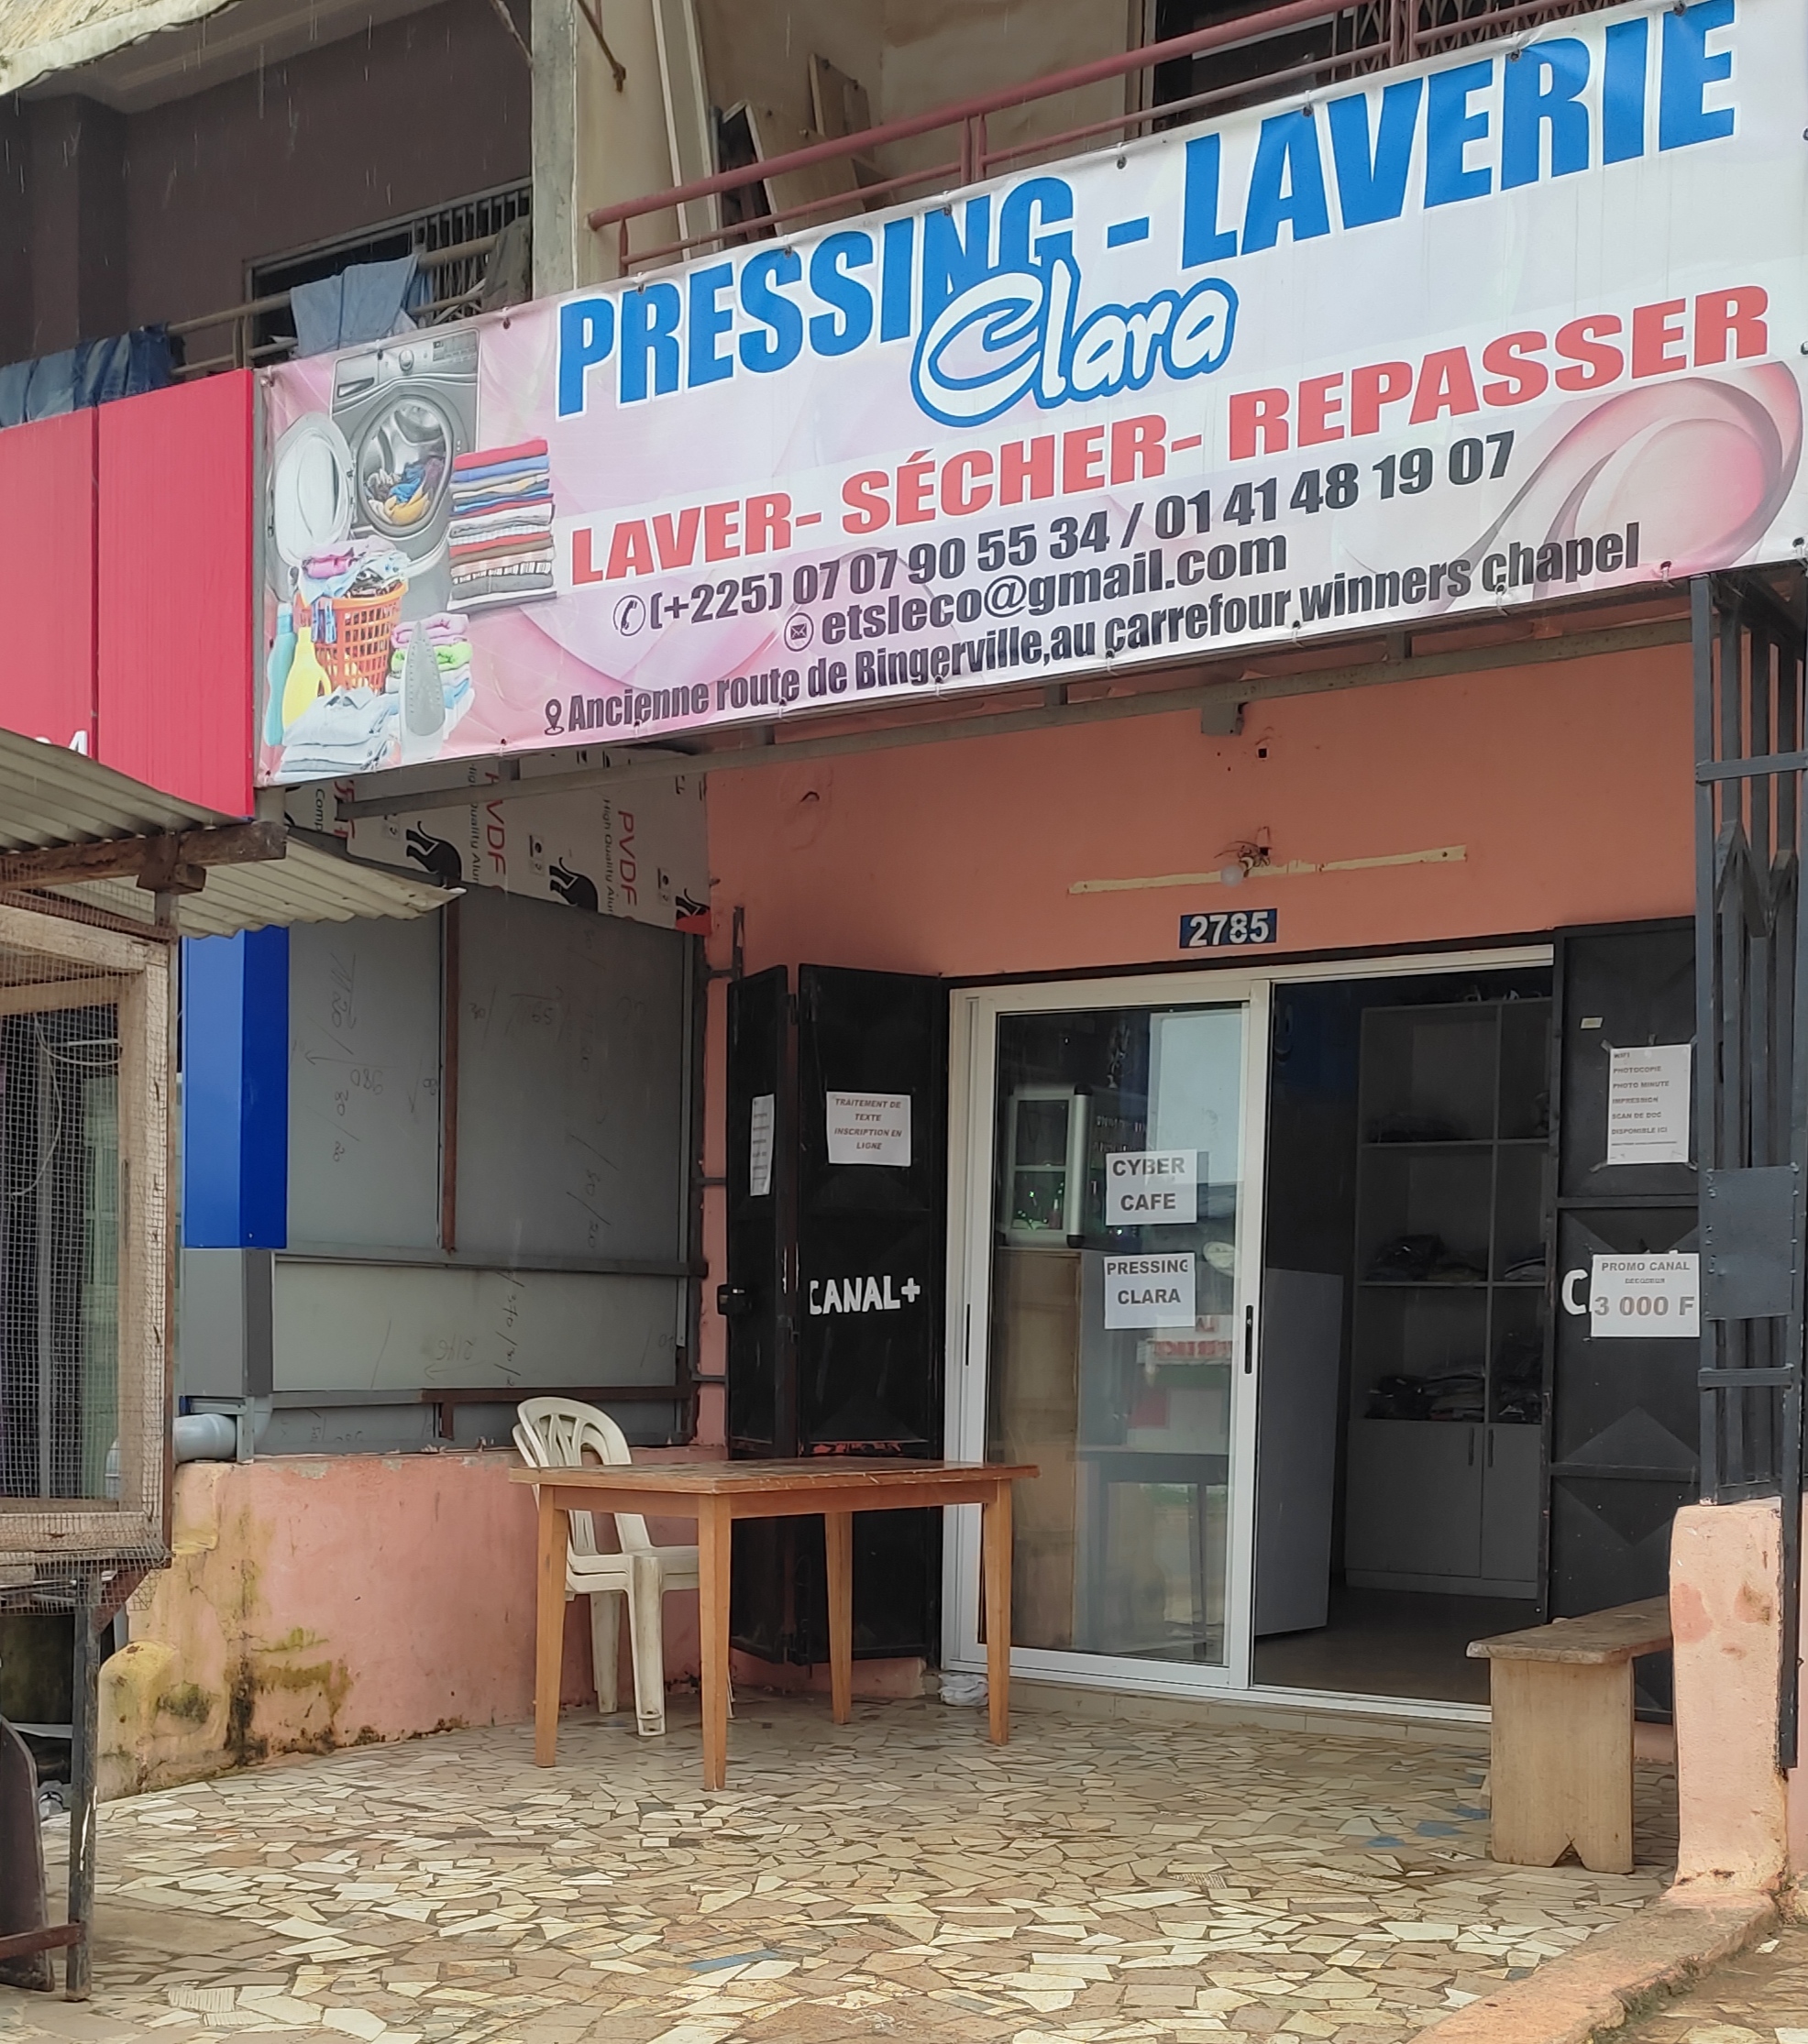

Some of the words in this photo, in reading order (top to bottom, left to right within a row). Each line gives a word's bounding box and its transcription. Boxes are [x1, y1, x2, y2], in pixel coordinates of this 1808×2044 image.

[558, 177, 1073, 417] PRESSING
[1108, 217, 1150, 248] -
[1182, 0, 1736, 269] LAVERIE
[912, 256, 1238, 427] Clara
[572, 493, 821, 586] LAVER-
[1229, 285, 1768, 460] REPASSER
[650, 572, 782, 630] (+225)
[792, 559, 841, 605] 07
[850, 549, 898, 595] 07
[908, 538, 965, 585] 90
[977, 523, 1037, 572] 55
[1050, 511, 1109, 560] 34
[1120, 502, 1144, 550] /
[1155, 489, 1211, 539] 01
[1223, 477, 1277, 526] 41
[1290, 463, 1359, 514] 48
[1373, 447, 1433, 500] 19
[1449, 430, 1515, 486] 07
[821, 534, 1286, 645] etsleco@gmail.com
[568, 683, 709, 732] Ancienne
[717, 668, 799, 711] route
[808, 657, 847, 698] de
[1105, 590, 1291, 654] carrefour
[1300, 559, 1471, 623] winners
[1482, 522, 1639, 592] chapel
[601, 798, 612, 830] High
[603, 834, 613, 883] Quality
[618, 810, 638, 907] PVDF
[1188, 911, 1270, 947] 2785
[1614, 1065, 1661, 1074] PHOTOCOPIE
[835, 1098, 887, 1108] TRAITEMENT
[854, 1113, 882, 1122] TEXTE
[834, 1127, 889, 1137] INSCRIPTION
[891, 1129, 902, 1137] EN
[855, 1142, 882, 1150] LIGNE
[1112, 1157, 1185, 1177] CYBER
[1120, 1192, 1176, 1212] CAFE
[1107, 1258, 1188, 1276] PRESSING
[1601, 1261, 1646, 1271] PROMO
[1649, 1261, 1691, 1270] CANAL
[810, 1275, 921, 1315] CANAL+
[1117, 1288, 1182, 1305] CLARA
[1594, 1296, 1610, 1316] 3
[1619, 1296, 1669, 1316] 000
[1679, 1296, 1695, 1316] F
